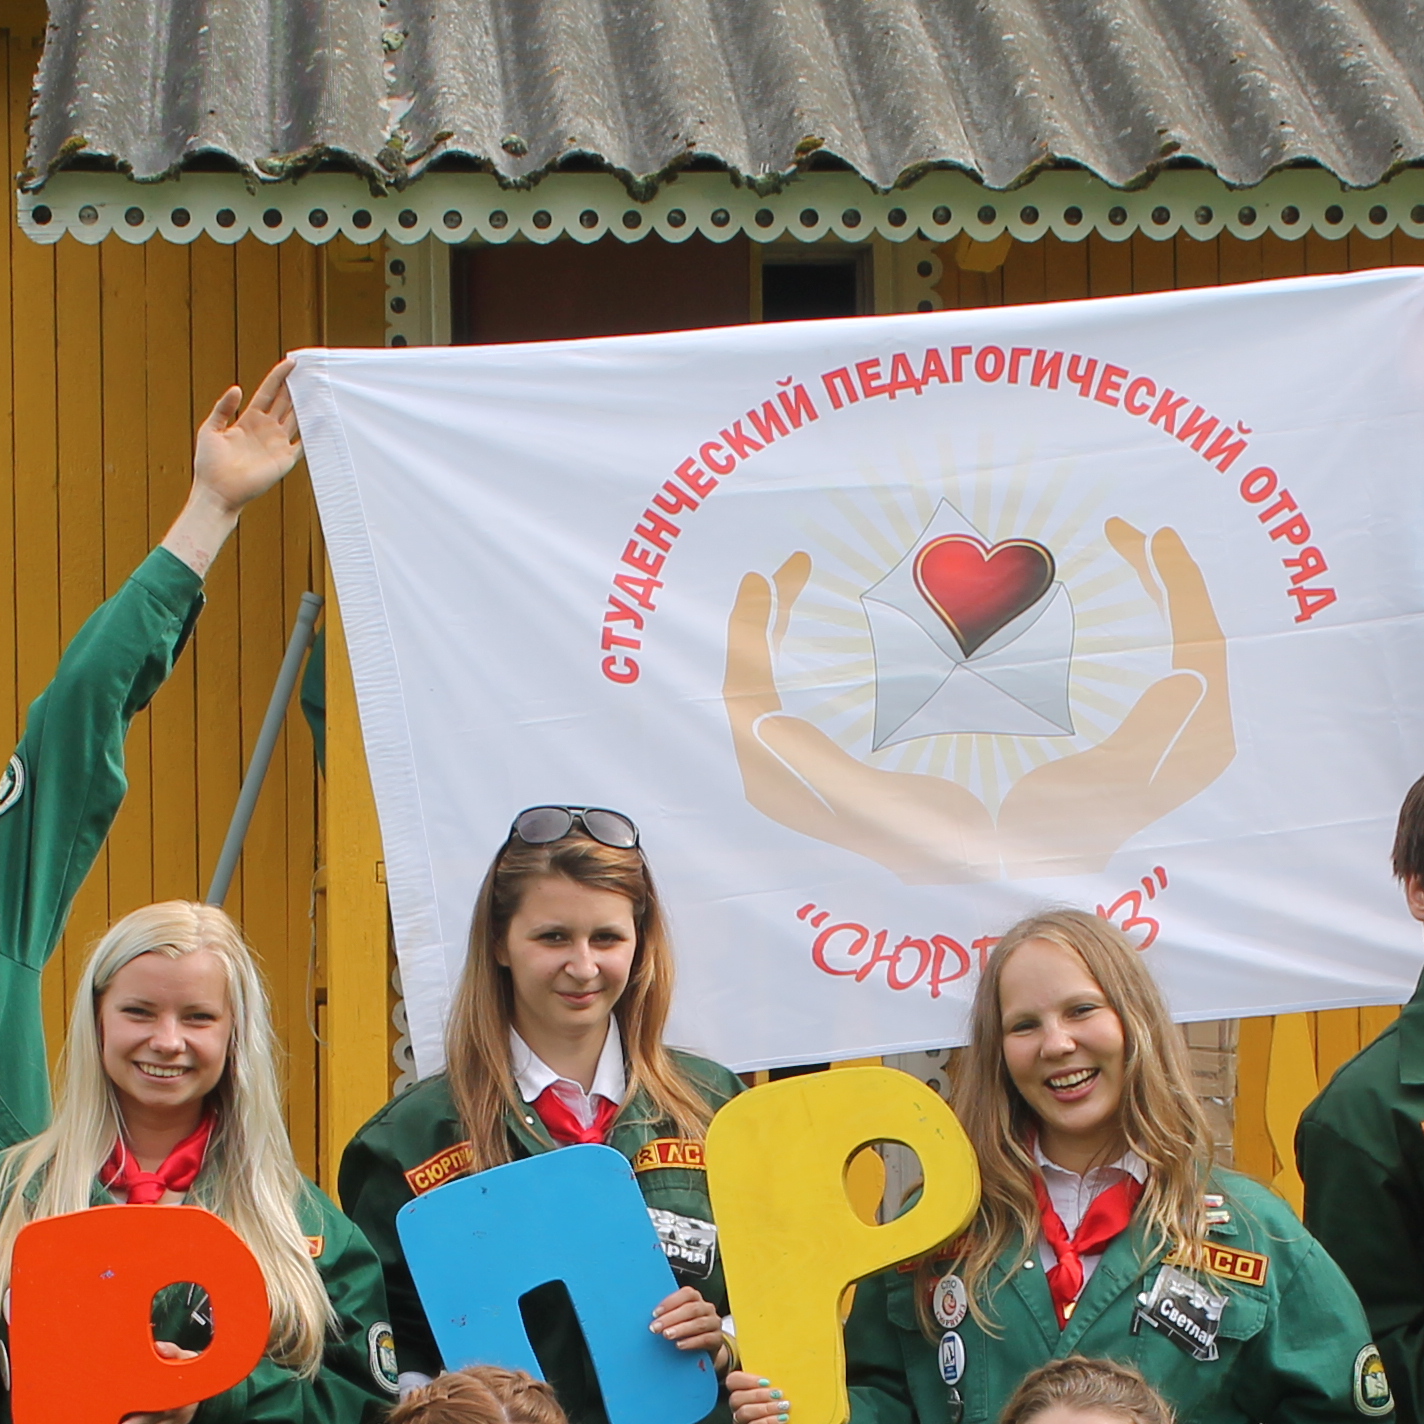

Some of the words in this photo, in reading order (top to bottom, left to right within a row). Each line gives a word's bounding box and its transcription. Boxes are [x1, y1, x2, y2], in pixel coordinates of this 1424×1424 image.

[601, 376, 820, 685] СТУДЕНЧЕСКИЙ
[822, 344, 1253, 474] ПЕДАГОГИЧЕСКИЙ
[1239, 465, 1338, 624] ОТРЯД
